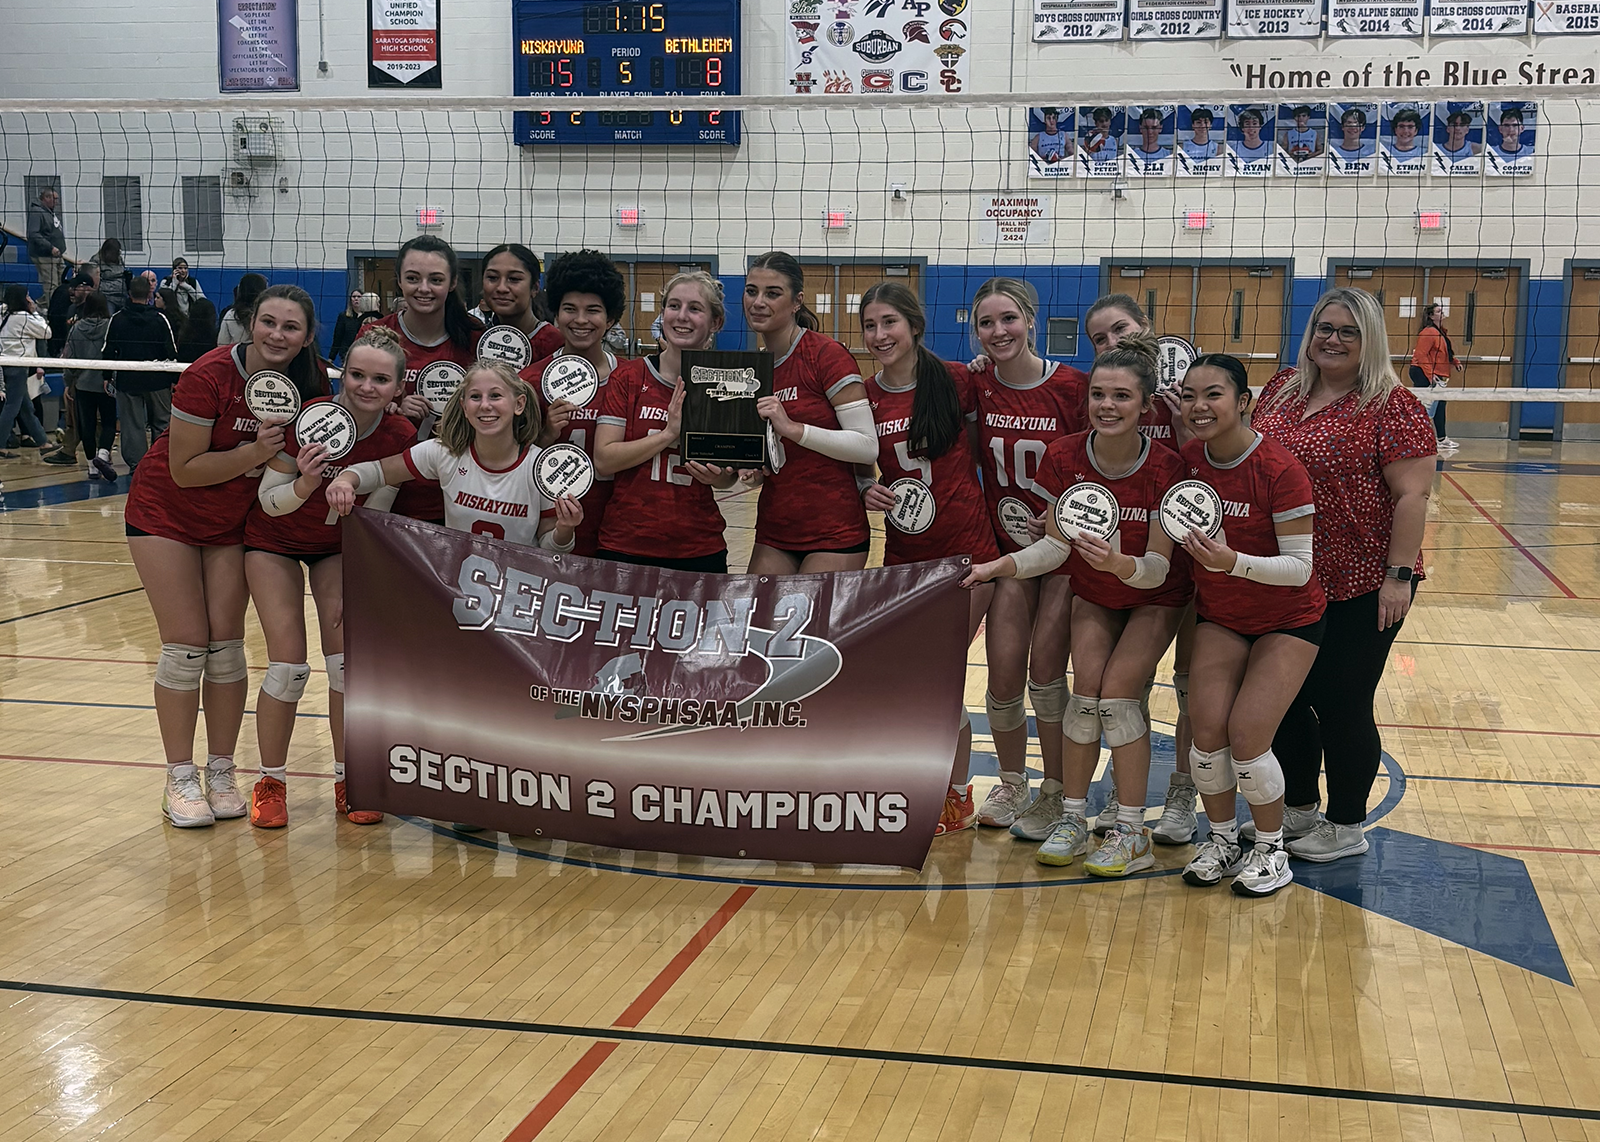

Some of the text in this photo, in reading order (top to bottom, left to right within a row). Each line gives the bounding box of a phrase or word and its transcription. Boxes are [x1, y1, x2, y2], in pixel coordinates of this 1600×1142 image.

[790, 0, 817, 14] Shen
[1245, 9, 1304, 19] ICE HOCKEY
[1333, 8, 1418, 17] BOYS ALPINE SKIING
[1431, 5, 1527, 16] GIRLS CROSS COUNTRY
[615, 4, 664, 32] 1:15
[1035, 12, 1122, 22] BOYS CROSS COUNTRY
[1131, 10, 1221, 20] GIRLS CROSS COUNTRY
[1161, 22, 1190, 35] 2012
[1258, 21, 1289, 33] 2013
[1360, 20, 1390, 32] 2014
[1462, 18, 1493, 30] 2014
[1566, 16, 1599, 29] 2015
[1063, 25, 1092, 37] 2012
[521, 40, 584, 54] NISKAYUNA
[612, 48, 641, 57] PERIOD
[665, 38, 732, 53] BETHLEHEM
[856, 38, 898, 55] SUBURBAN
[550, 59, 572, 86] 15
[620, 62, 632, 84] 5
[706, 58, 721, 86] 8
[1342, 62, 1372, 87] of
[1383, 61, 1430, 86] the
[1444, 61, 1507, 85] Blue
[900, 69, 928, 93] C
[530, 130, 555, 139] SCORE
[615, 131, 642, 139] MATCH
[699, 130, 726, 139] SCORE
[1144, 163, 1164, 171] ELI
[986, 209, 1043, 217] OCCUPANCY
[488, 341, 516, 354] SECTION
[551, 371, 577, 389] SECTION
[692, 368, 753, 384] SECTION 2
[254, 390, 282, 399] SECTION
[986, 413, 1056, 431] NISKAYUNA
[989, 437, 1048, 489] 10
[546, 459, 569, 485] SECTION
[566, 465, 589, 486] VOLLEYBALL
[454, 491, 529, 518] NISKAYUNA
[1069, 499, 1100, 516] SECTION
[1176, 494, 1204, 518] SECTION
[1164, 508, 1176, 519] GIRLS
[1060, 516, 1106, 535] GIRLS VOLLEYBALL
[453, 553, 814, 659] SECTION 2
[530, 685, 548, 700] OF
[552, 688, 579, 705] THE
[388, 744, 908, 833] SECTION 2 CHAMPIONS
